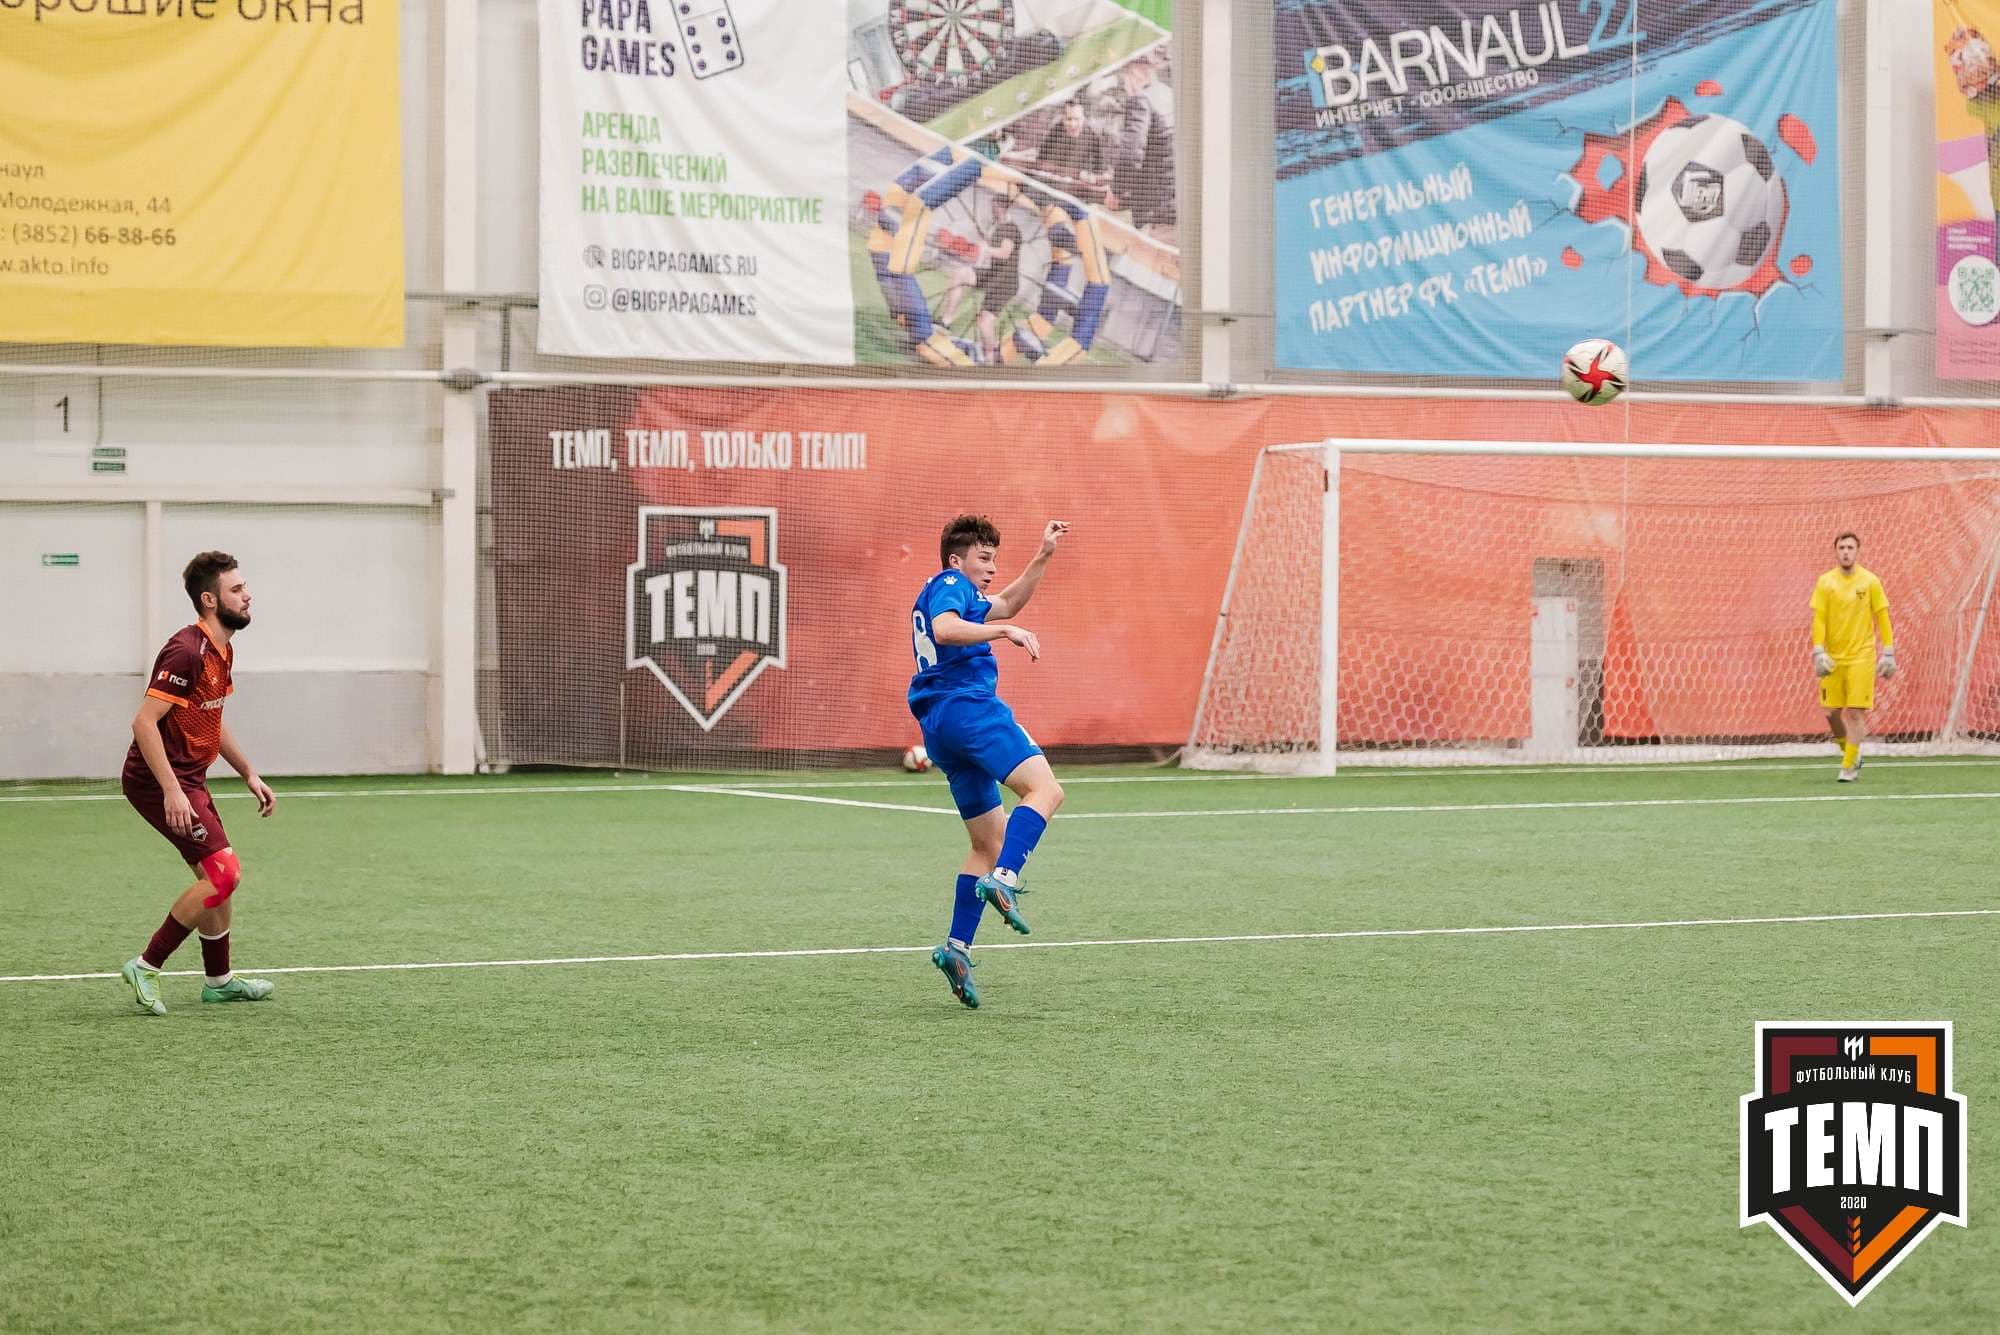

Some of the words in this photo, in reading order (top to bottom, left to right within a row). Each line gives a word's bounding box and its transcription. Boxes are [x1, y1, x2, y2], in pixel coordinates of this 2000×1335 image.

[0, 0, 217, 21] ршие
[237, 0, 363, 24] окна
[582, 0, 652, 33] PAPA
[582, 34, 676, 77] GAMES
[1315, 96, 1404, 127] ИНТЕРНЕТ
[1419, 68, 1539, 107] СООБЩЕСТВО
[582, 111, 662, 144] АРЕНДА
[582, 148, 728, 183] РАЗВЛЕЧЕНИЙ
[146, 196, 172, 213] 44
[582, 185, 609, 213] НА
[615, 186, 675, 217] ВАШЕ
[680, 191, 823, 225] МЕРОПРИЯТИЕ
[1309, 161, 1473, 228] ГЕНЕРАЛЬНЫЙ
[12, 222, 78, 247] (3852)
[85, 226, 177, 246] 66-88-66
[1310, 200, 1532, 284] ИНФОРМАЦИОННЫЙ
[611, 248, 758, 277] BIGPAPAGAMES.RU
[611, 287, 757, 316] @BIGPAPAGAMES
[1309, 282, 1414, 335] ПАРТНЕР
[1418, 272, 1459, 308] ФК
[1464, 254, 1549, 297] «ТЕМП»
[55, 395, 69, 432] 1
[550, 429, 618, 472] ТЕМП,
[625, 429, 695, 473] ТЕМП,
[702, 430, 793, 470] ТОЛЬКО
[799, 431, 867, 470] ТЕМП!
[645, 569, 771, 645] ТЕМП
